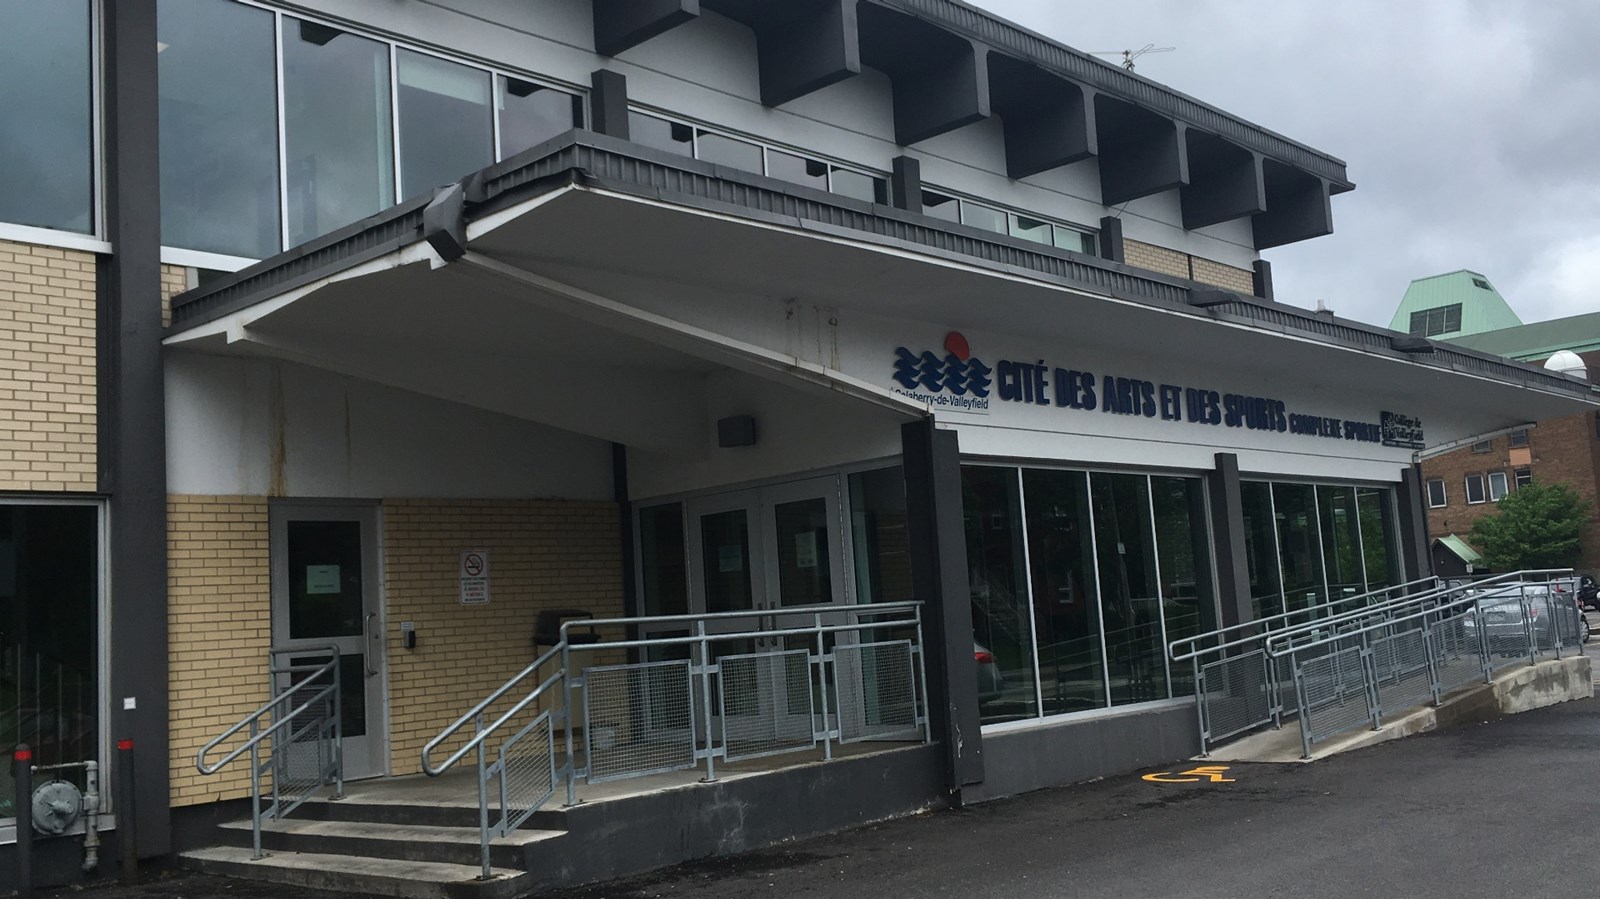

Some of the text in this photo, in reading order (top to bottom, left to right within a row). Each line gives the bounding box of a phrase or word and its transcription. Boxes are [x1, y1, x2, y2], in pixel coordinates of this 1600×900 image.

[998, 359, 1381, 443] CITÉ DES ARTS ET DES SPORTS COMPLEXE SPORTIF
